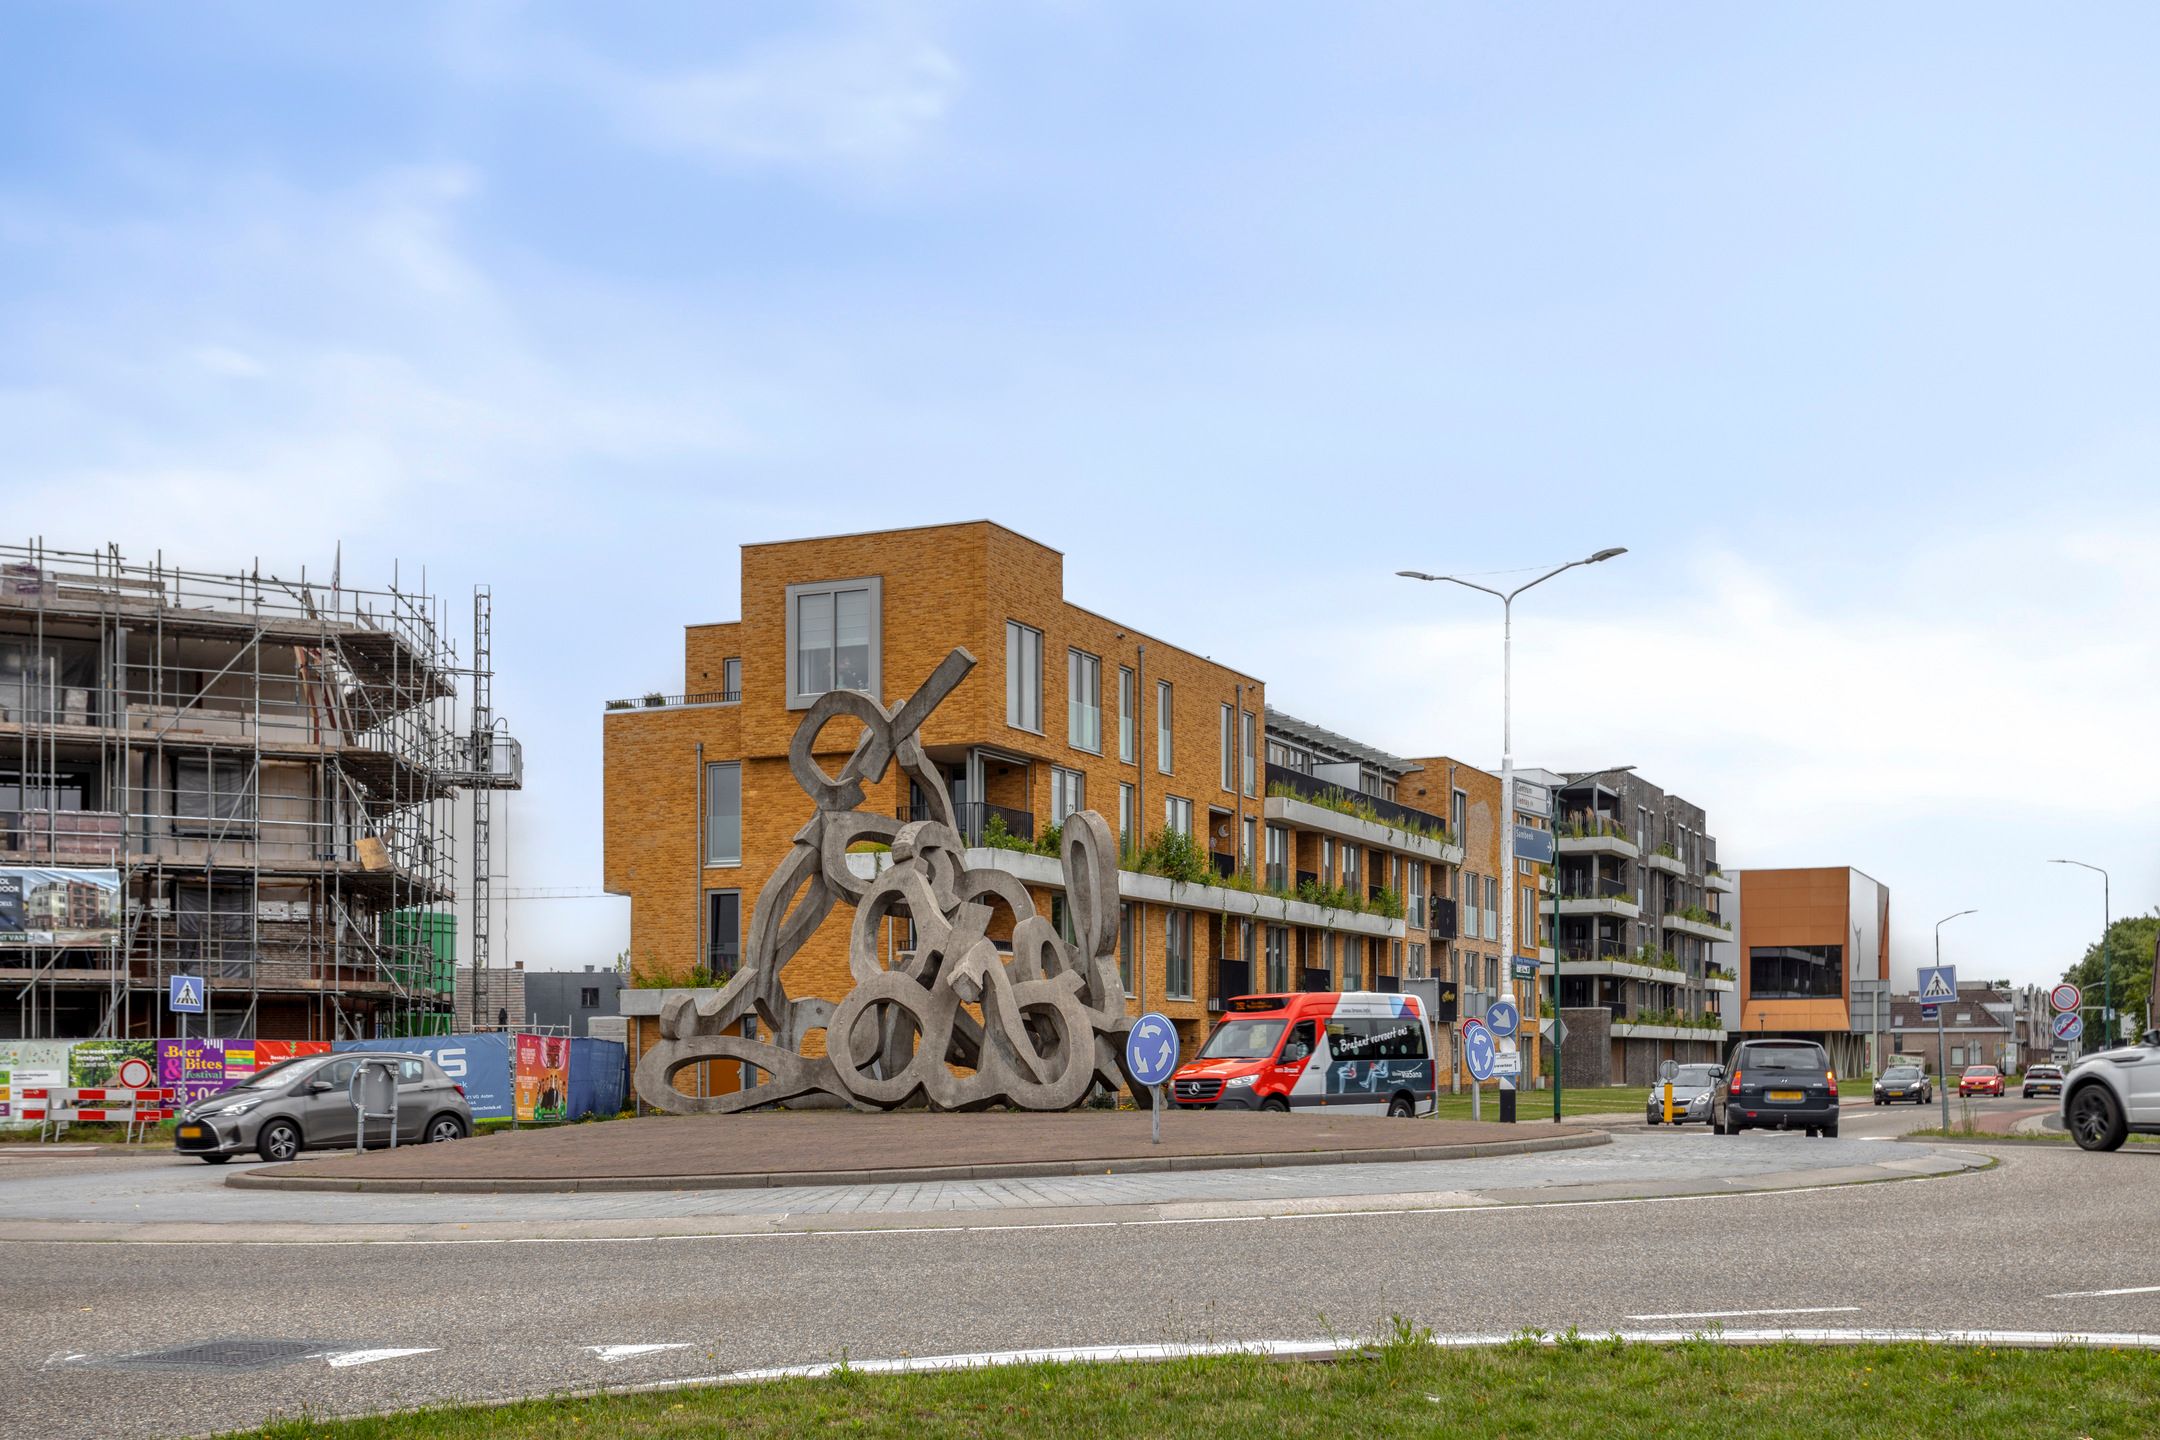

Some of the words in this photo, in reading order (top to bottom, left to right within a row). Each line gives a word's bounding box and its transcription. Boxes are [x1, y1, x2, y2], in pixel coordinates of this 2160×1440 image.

[1516, 828, 1534, 841] Sambeek
[1339, 1034, 1369, 1052] Brabant
[1370, 1027, 1397, 1044] vervoert
[164, 1045, 203, 1057] Beer
[185, 1058, 223, 1070] Bites
[186, 1070, 222, 1079] festival
